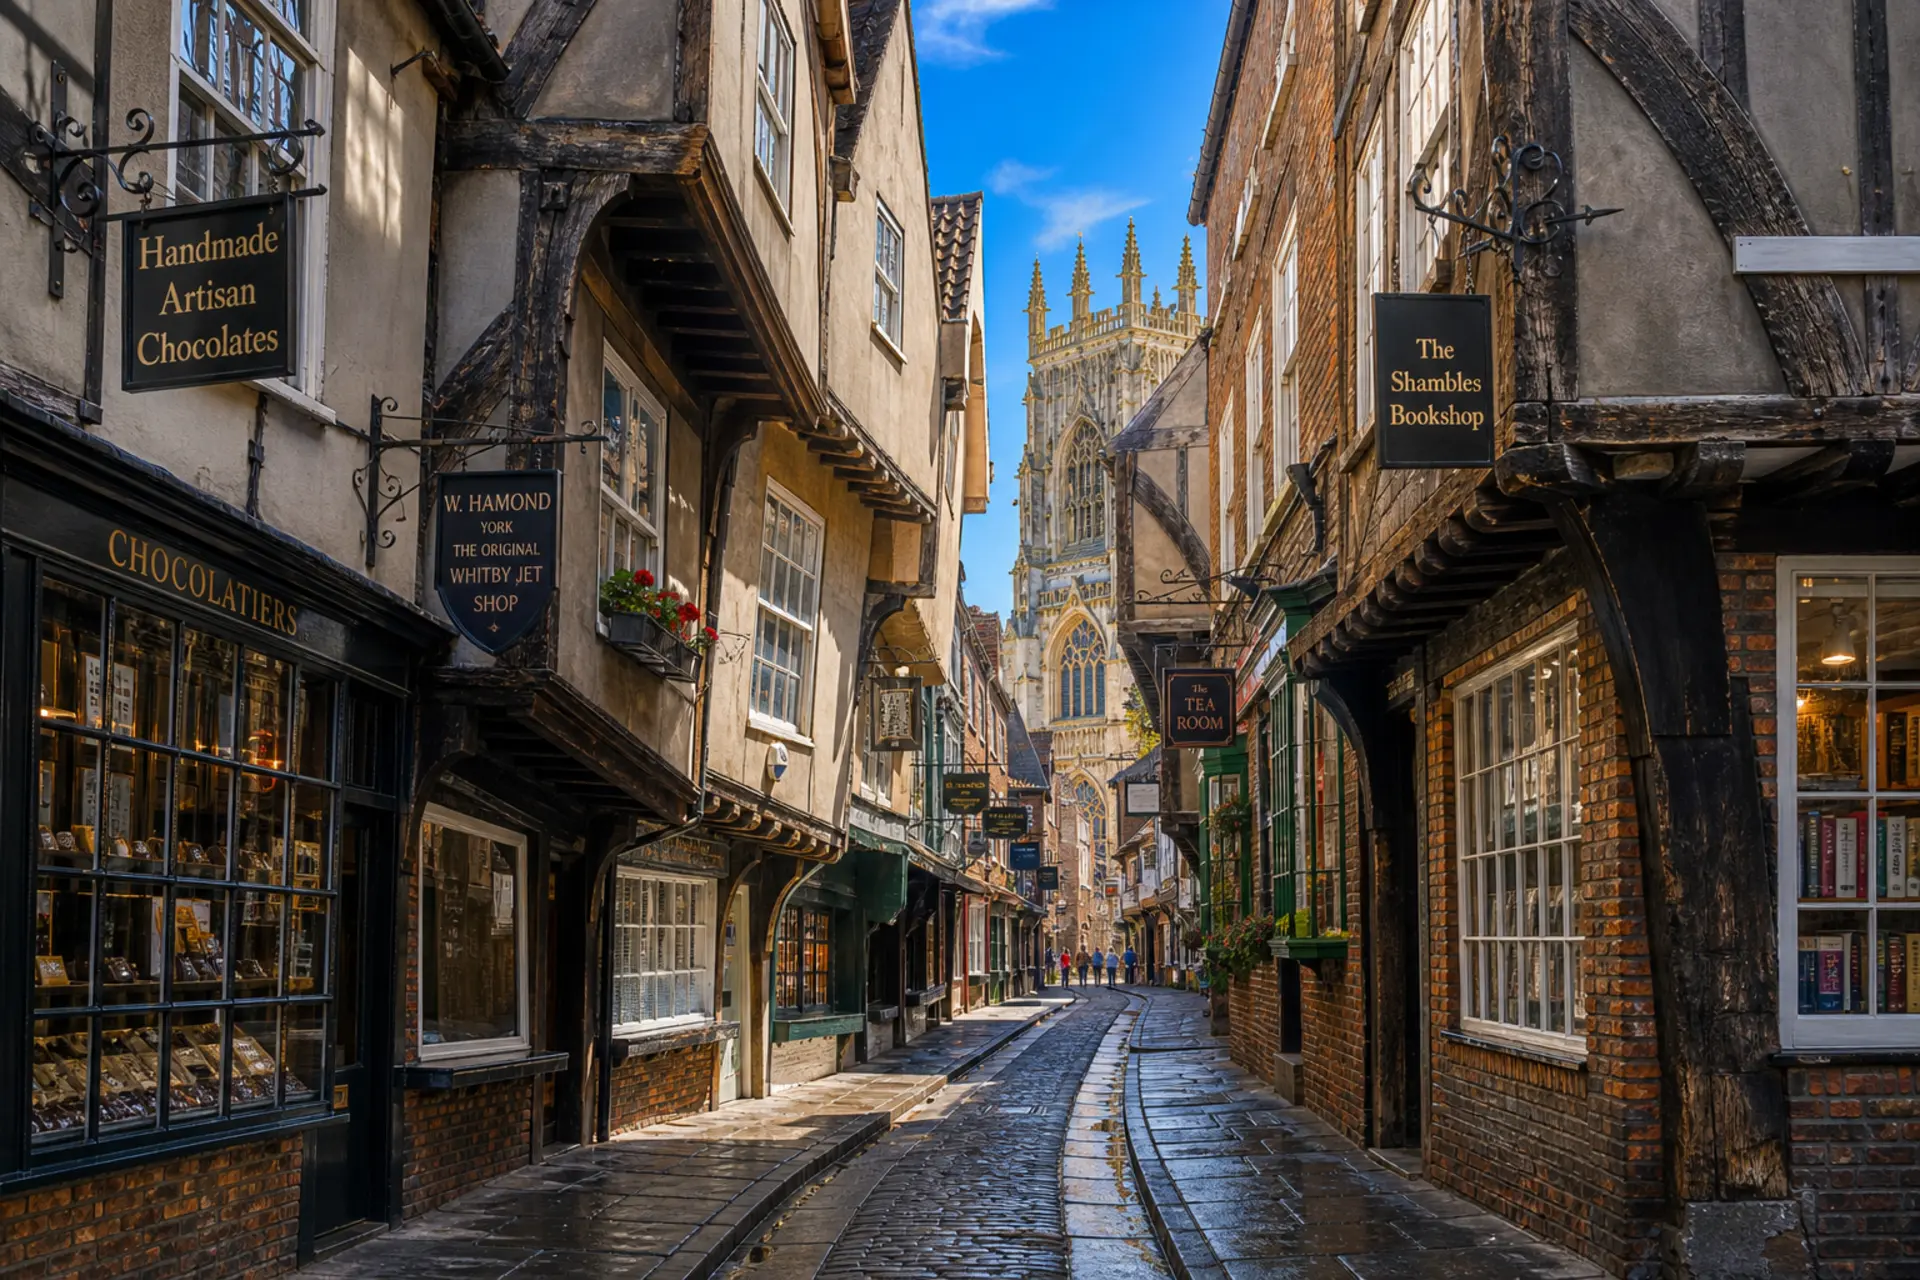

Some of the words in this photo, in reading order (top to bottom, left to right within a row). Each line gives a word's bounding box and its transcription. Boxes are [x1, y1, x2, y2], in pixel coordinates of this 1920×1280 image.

[138, 221, 279, 270] Handmade
[158, 279, 257, 316] Artisan
[136, 323, 279, 366] Chocolates
[1415, 338, 1455, 360] The
[1390, 370, 1482, 393] Shambles
[1389, 404, 1485, 431] Bookshop
[443, 494, 463, 513] W.
[468, 491, 552, 512] HAMOND
[480, 520, 513, 534] YORK
[453, 543, 478, 557] THE
[480, 542, 541, 557] ORIGINAL
[108, 529, 298, 637] CHOCOLATIERS
[450, 565, 512, 584] WHITBY
[515, 565, 544, 585] JET
[473, 594, 519, 612] SHOP
[1191, 684, 1209, 693] The
[1184, 697, 1216, 712] TEA
[1177, 715, 1224, 730] ROOM
